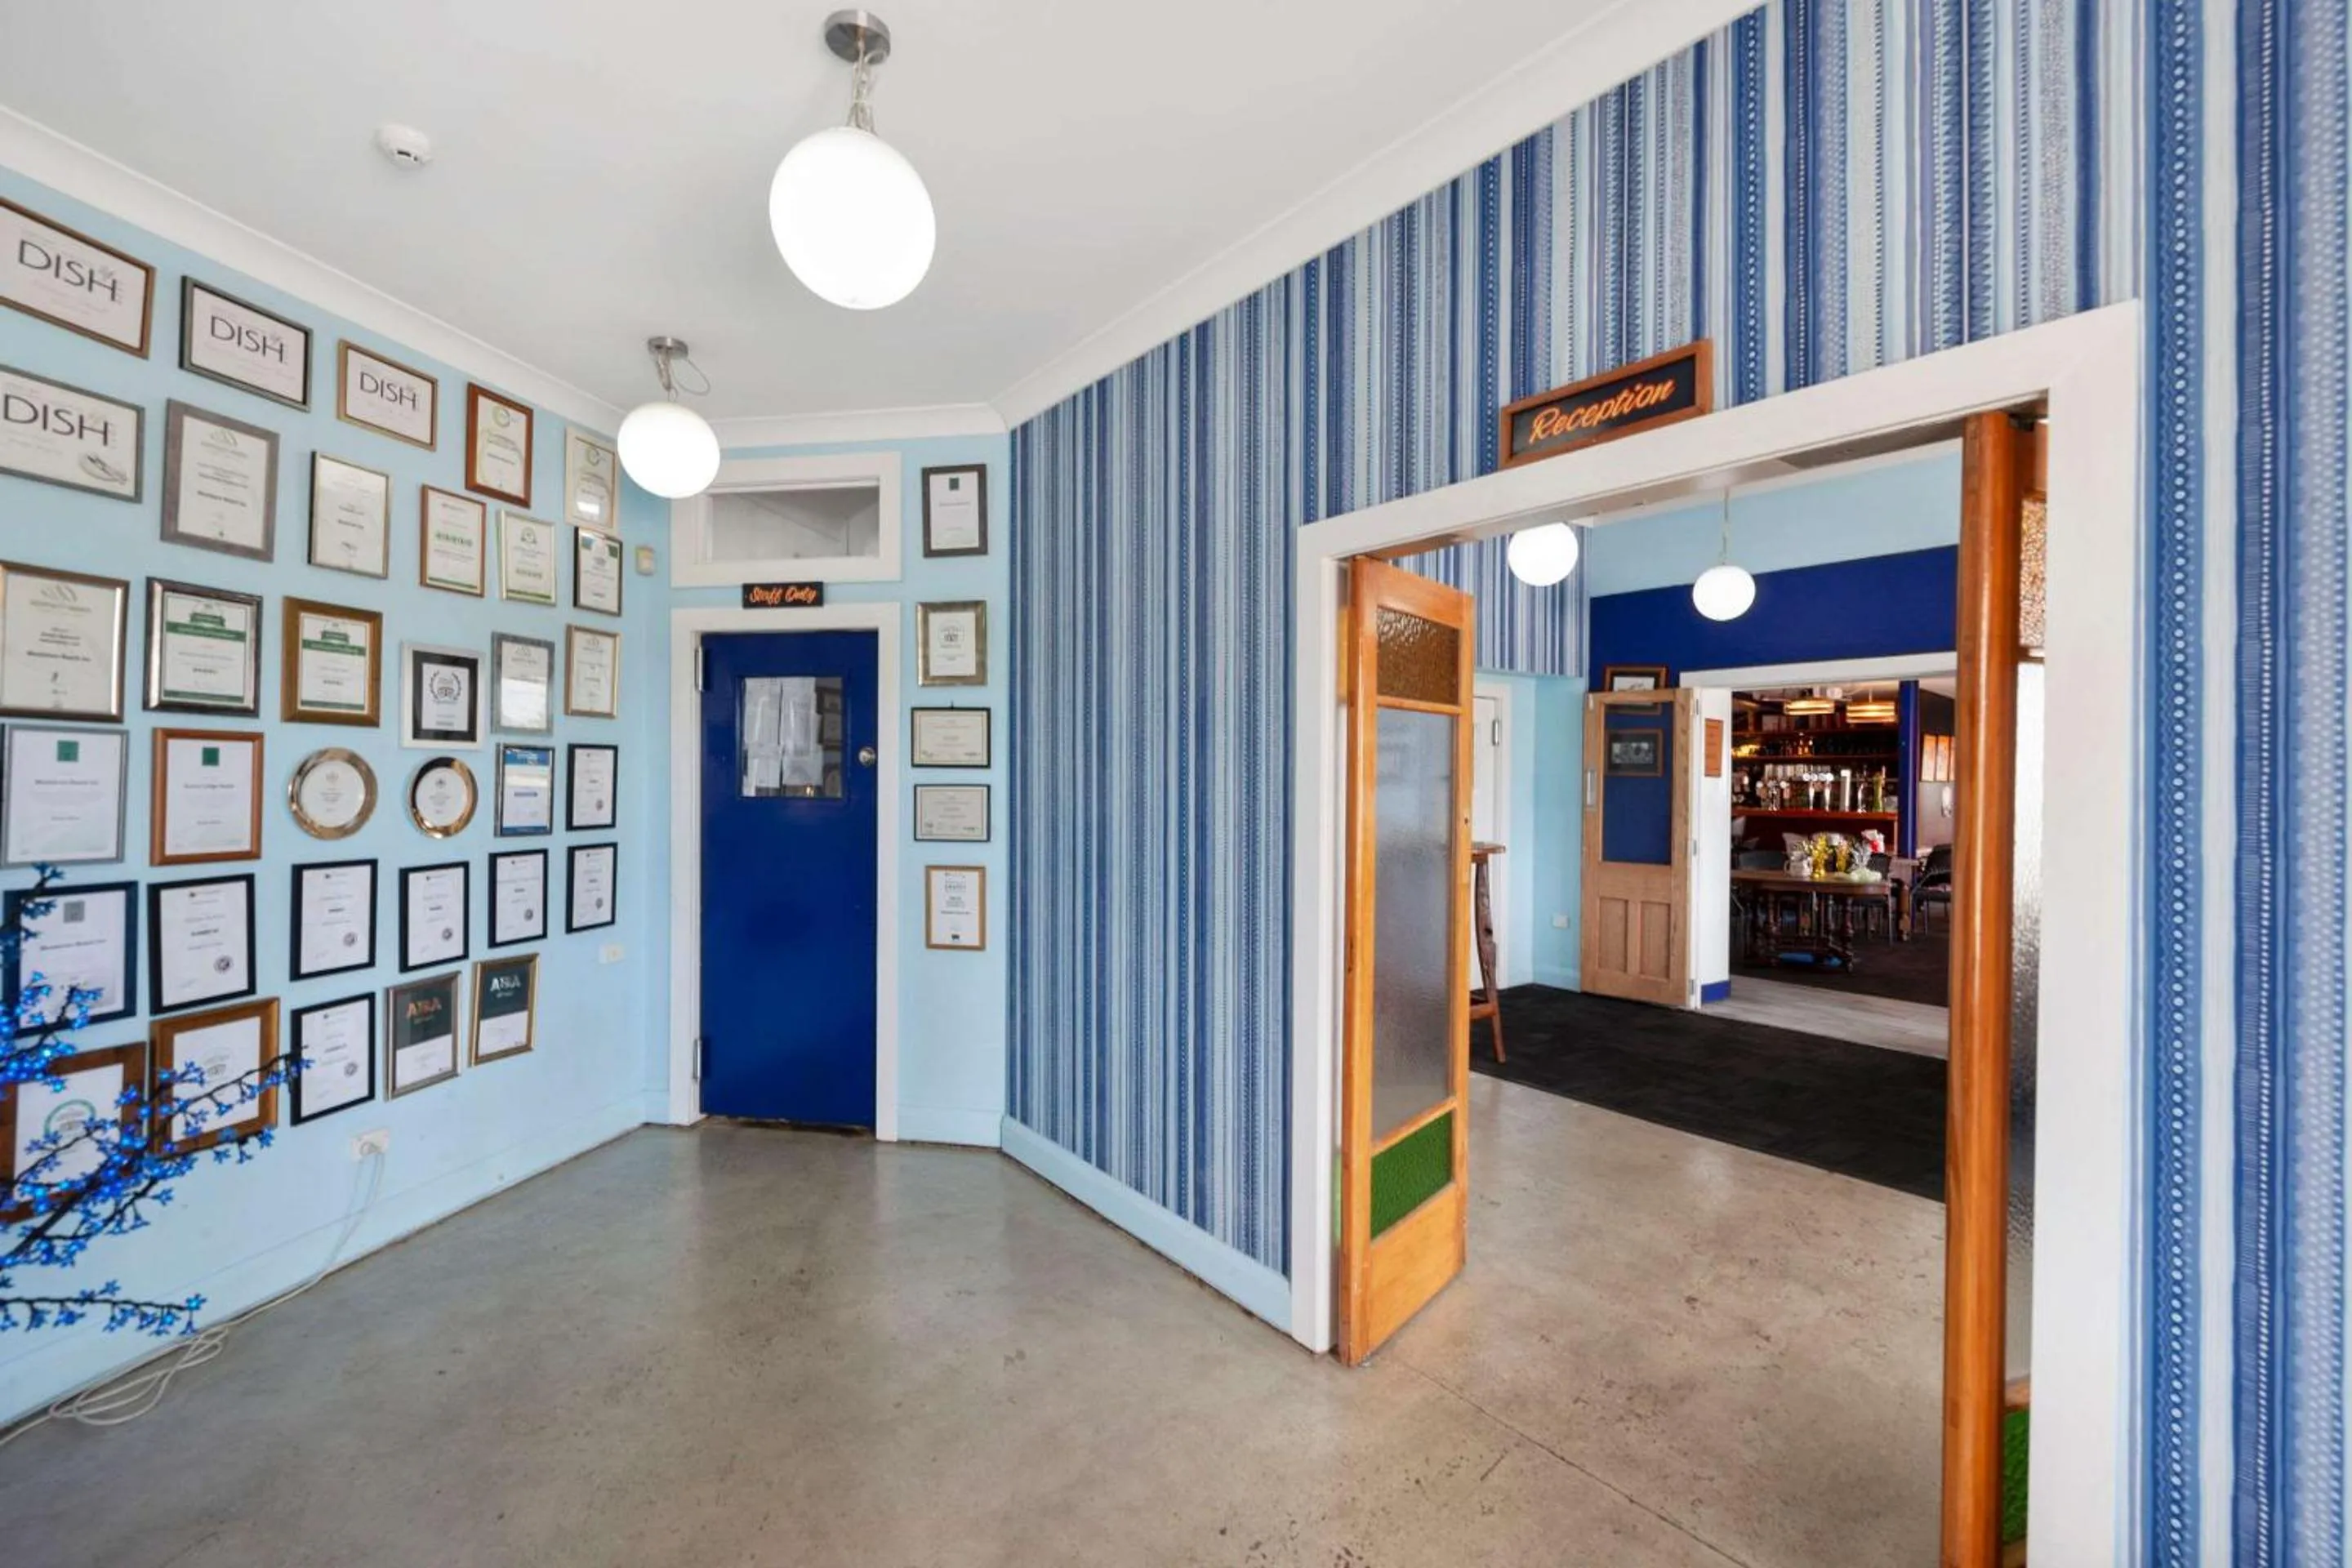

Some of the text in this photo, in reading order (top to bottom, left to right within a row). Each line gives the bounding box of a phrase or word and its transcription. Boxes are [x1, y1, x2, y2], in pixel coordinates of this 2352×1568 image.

[18, 239, 118, 301] DISH
[211, 314, 284, 363] DISH
[359, 371, 417, 412] DISH
[1529, 378, 1676, 444] Reception
[3, 394, 109, 447] DISH
